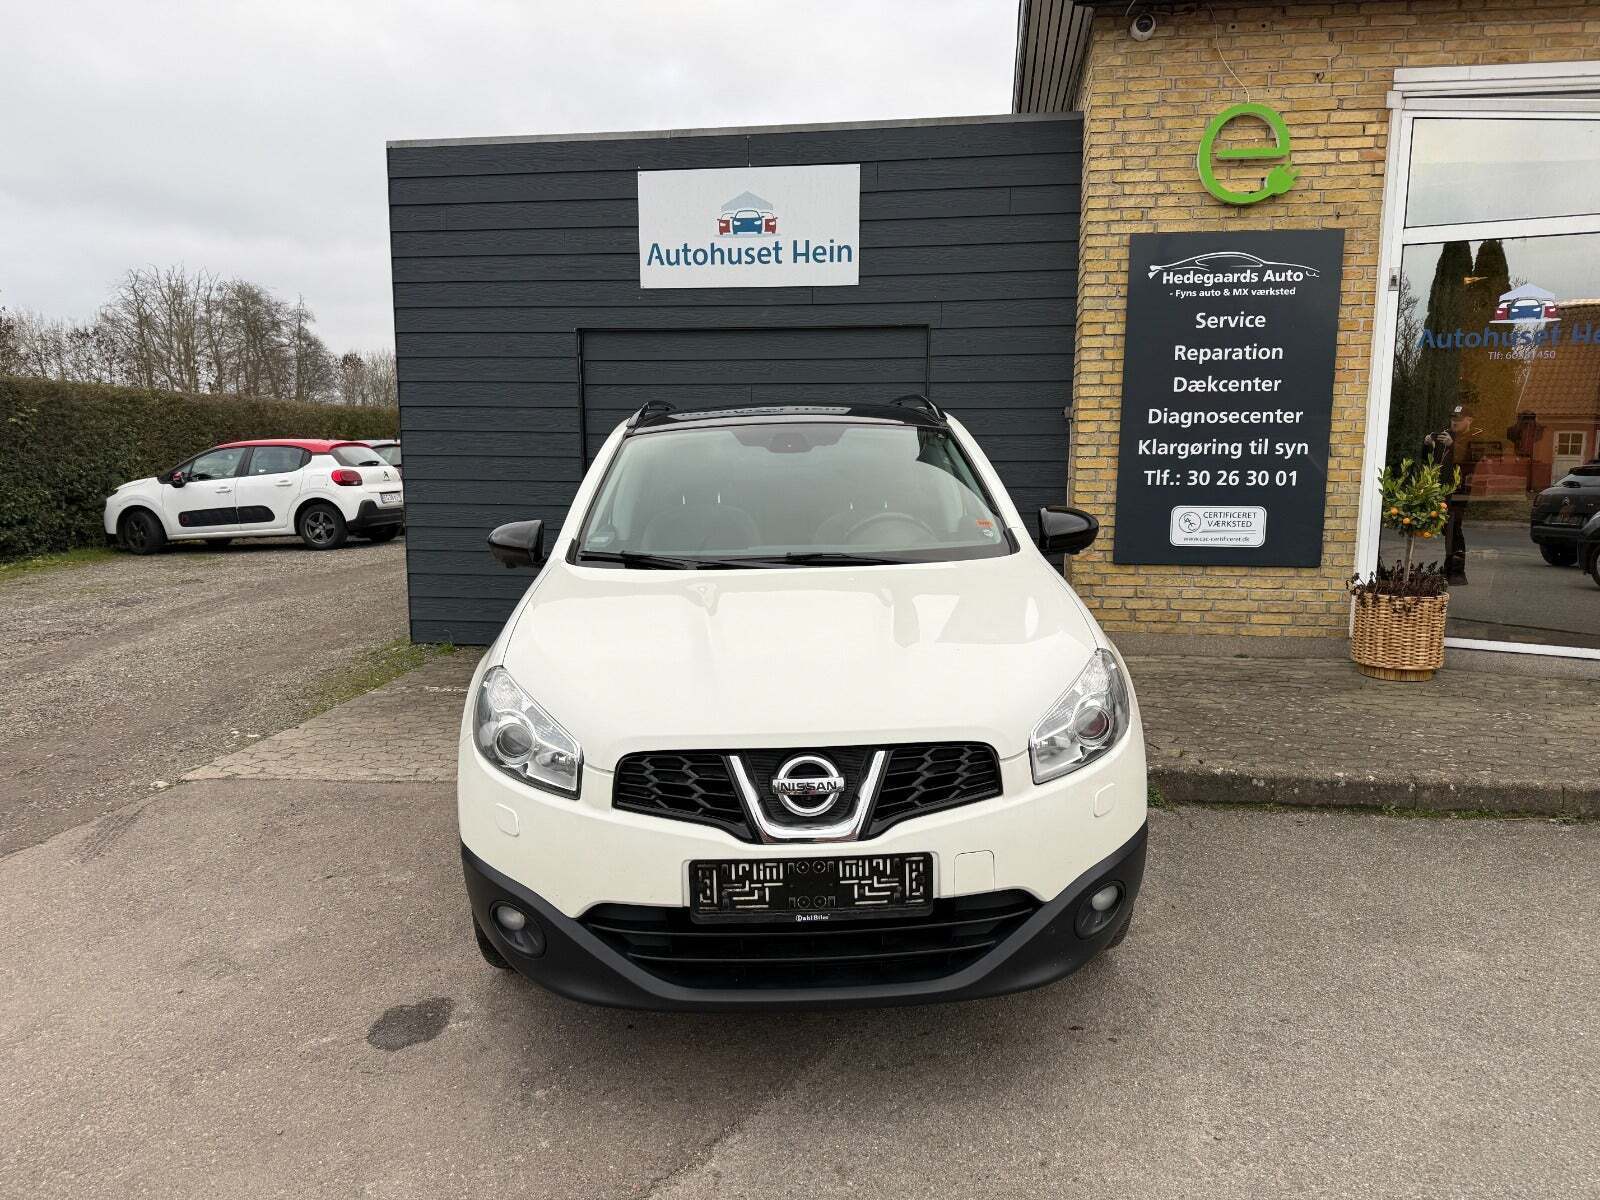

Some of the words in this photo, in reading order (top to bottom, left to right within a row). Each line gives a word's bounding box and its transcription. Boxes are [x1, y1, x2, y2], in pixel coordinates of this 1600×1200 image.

[646, 241, 782, 266] Autohuset
[792, 239, 852, 263] Hein
[1161, 268, 1259, 286] Hedegaards
[1262, 268, 1304, 282] Auto
[1175, 289, 1197, 298] Fyns
[1198, 289, 1221, 297] auto
[1222, 288, 1231, 296] &
[1232, 288, 1249, 296] MX
[1250, 287, 1296, 296] værksted
[1195, 311, 1266, 329] Service
[1417, 322, 1561, 349] Autohuset
[1174, 343, 1283, 364] Reparation
[1173, 376, 1281, 392] Dækcenter
[1148, 408, 1303, 428] Diagnosecenter
[1138, 439, 1242, 459] Klargøring
[1249, 438, 1269, 454] til
[1275, 442, 1309, 459] syn
[1144, 469, 1181, 486] Tlf.:
[1187, 471, 1210, 486] 30
[1216, 471, 1239, 486] 26
[1246, 471, 1269, 486] 30
[1275, 471, 1297, 486] 01
[1207, 520, 1252, 528] VÆRKSTED
[780, 781, 837, 792] NISSAN
